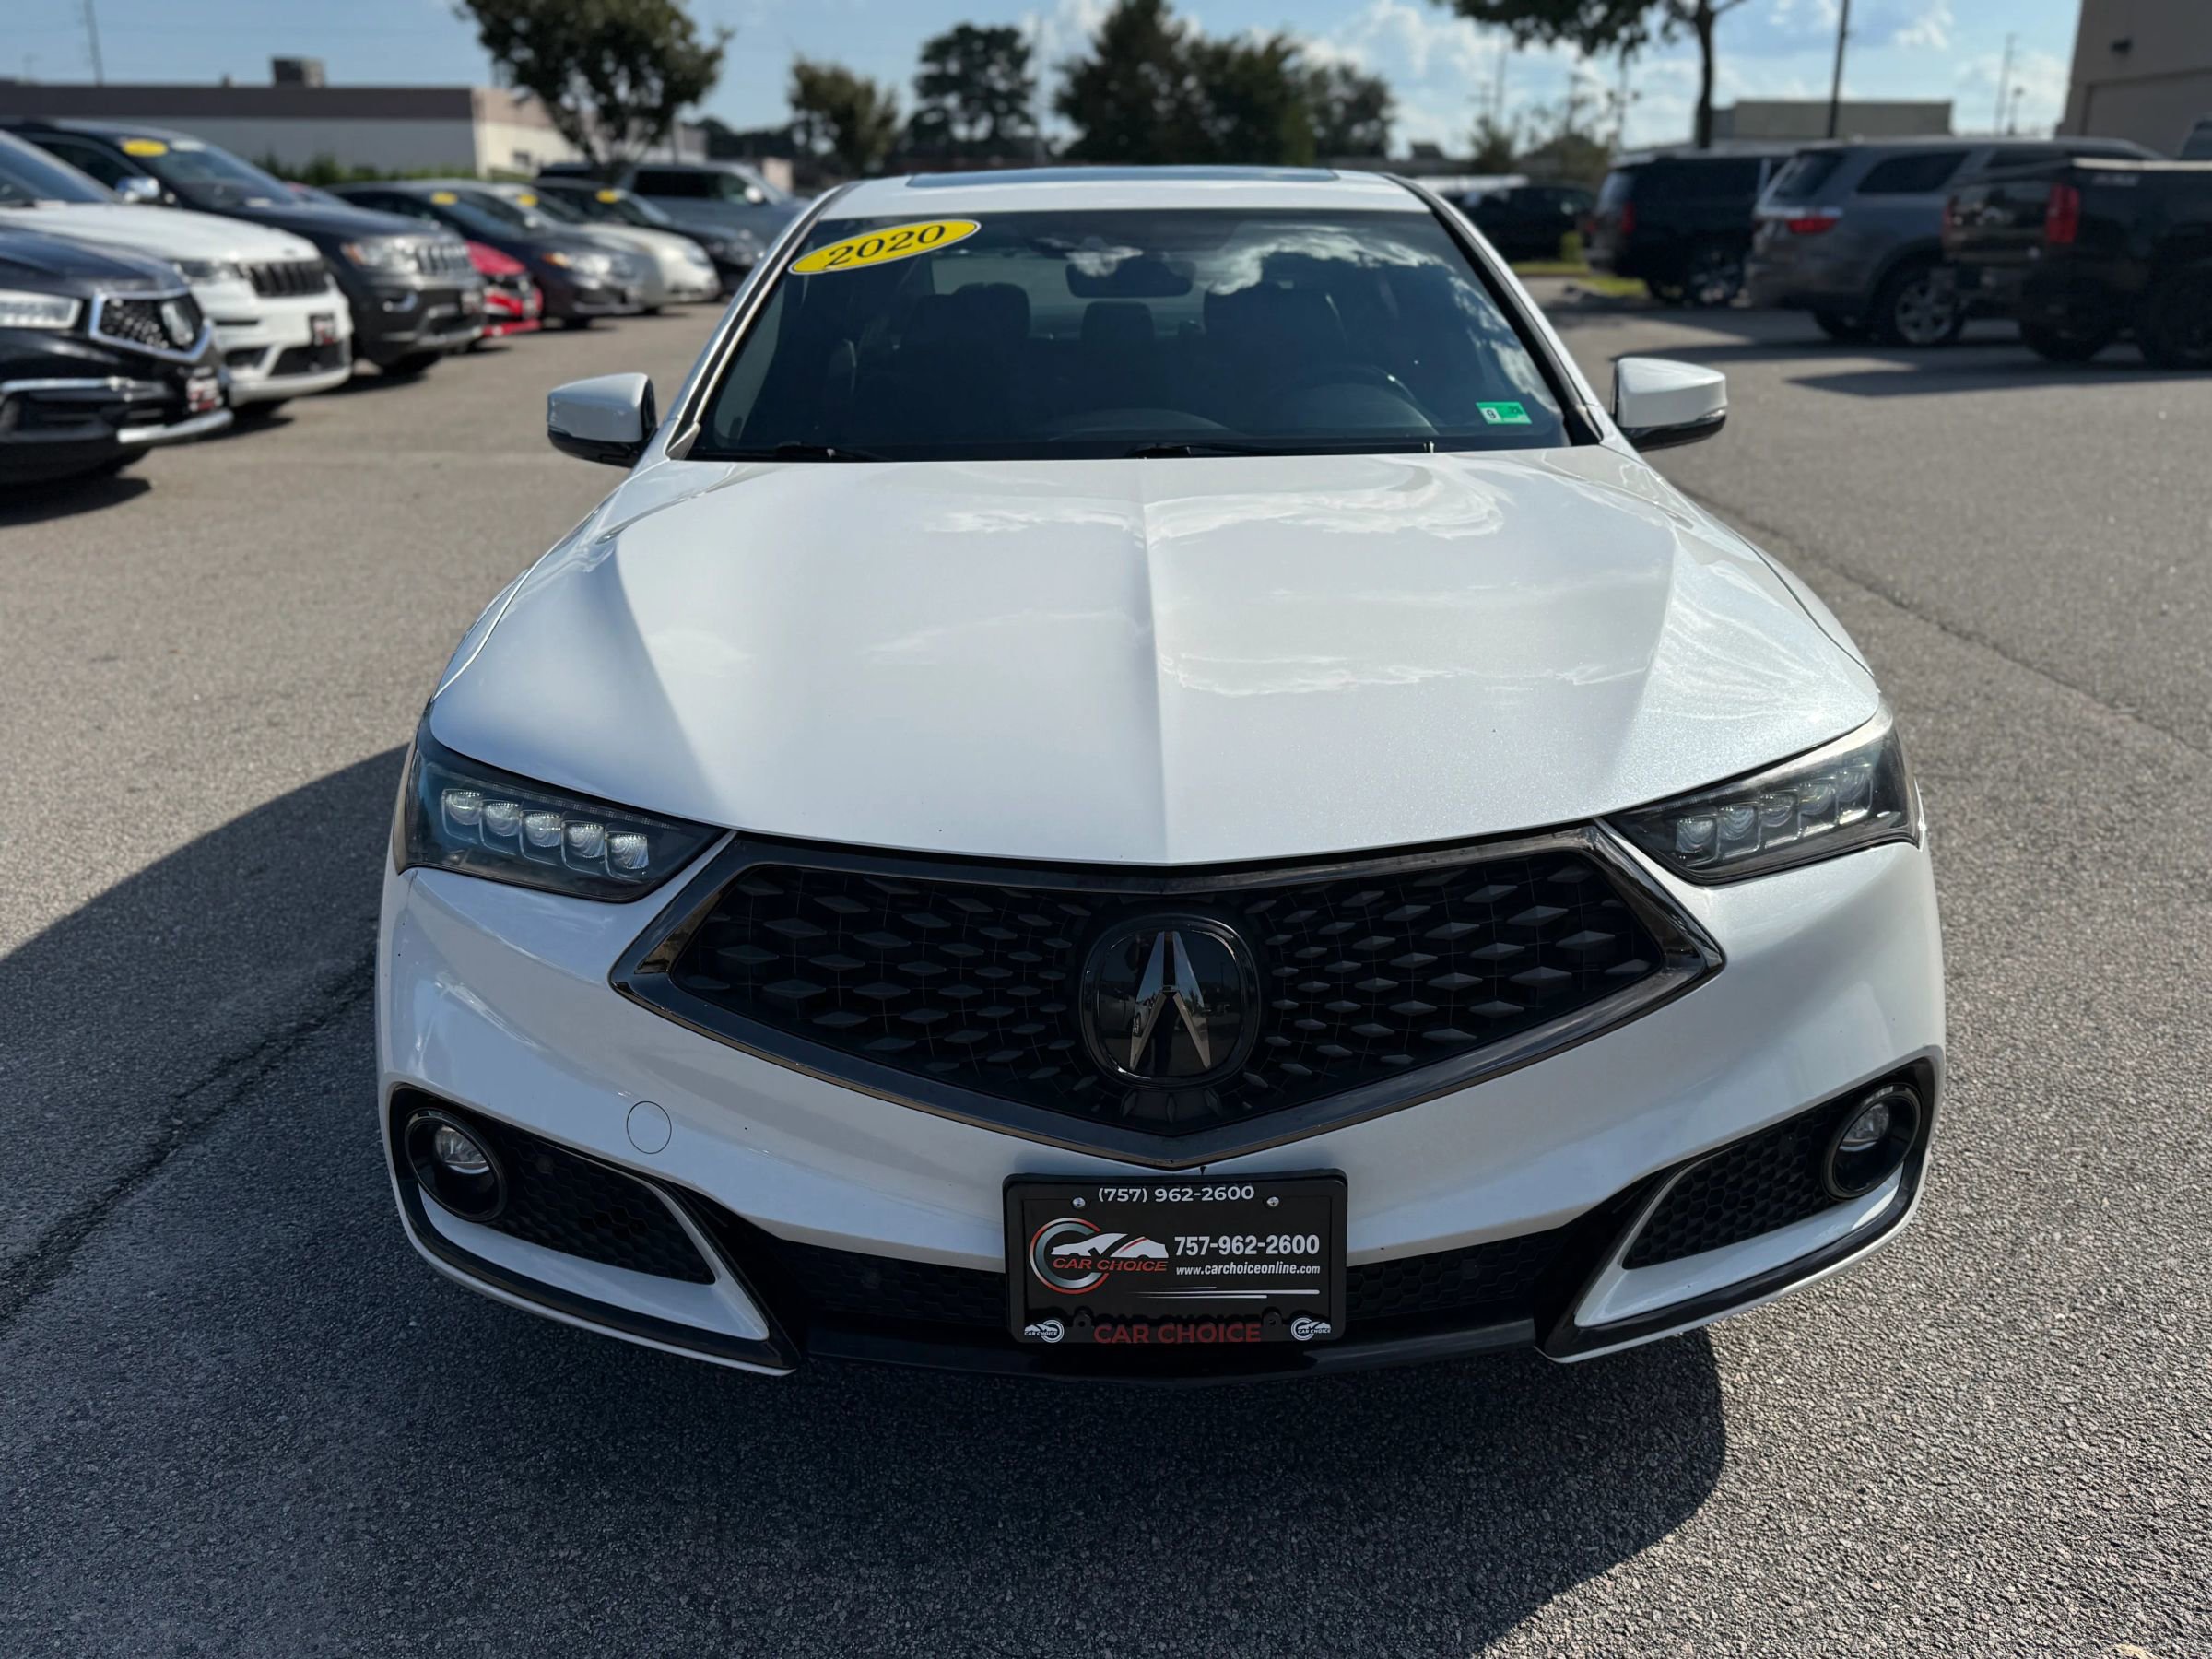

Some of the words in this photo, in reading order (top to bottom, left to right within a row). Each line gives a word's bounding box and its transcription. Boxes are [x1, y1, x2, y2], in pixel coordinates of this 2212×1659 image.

[824, 225, 946, 268] 2020
[1098, 1187, 1148, 1203] (757)
[1154, 1185, 1255, 1203] 962-2600
[1174, 1234, 1321, 1256] 757-962-2600
[1053, 1257, 1092, 1270] CAR
[1097, 1259, 1170, 1272] CHOICE
[1176, 1261, 1321, 1276] www.carchoiceonline.com
[1093, 1323, 1150, 1344] CAR
[1157, 1321, 1262, 1344] CHOICE
